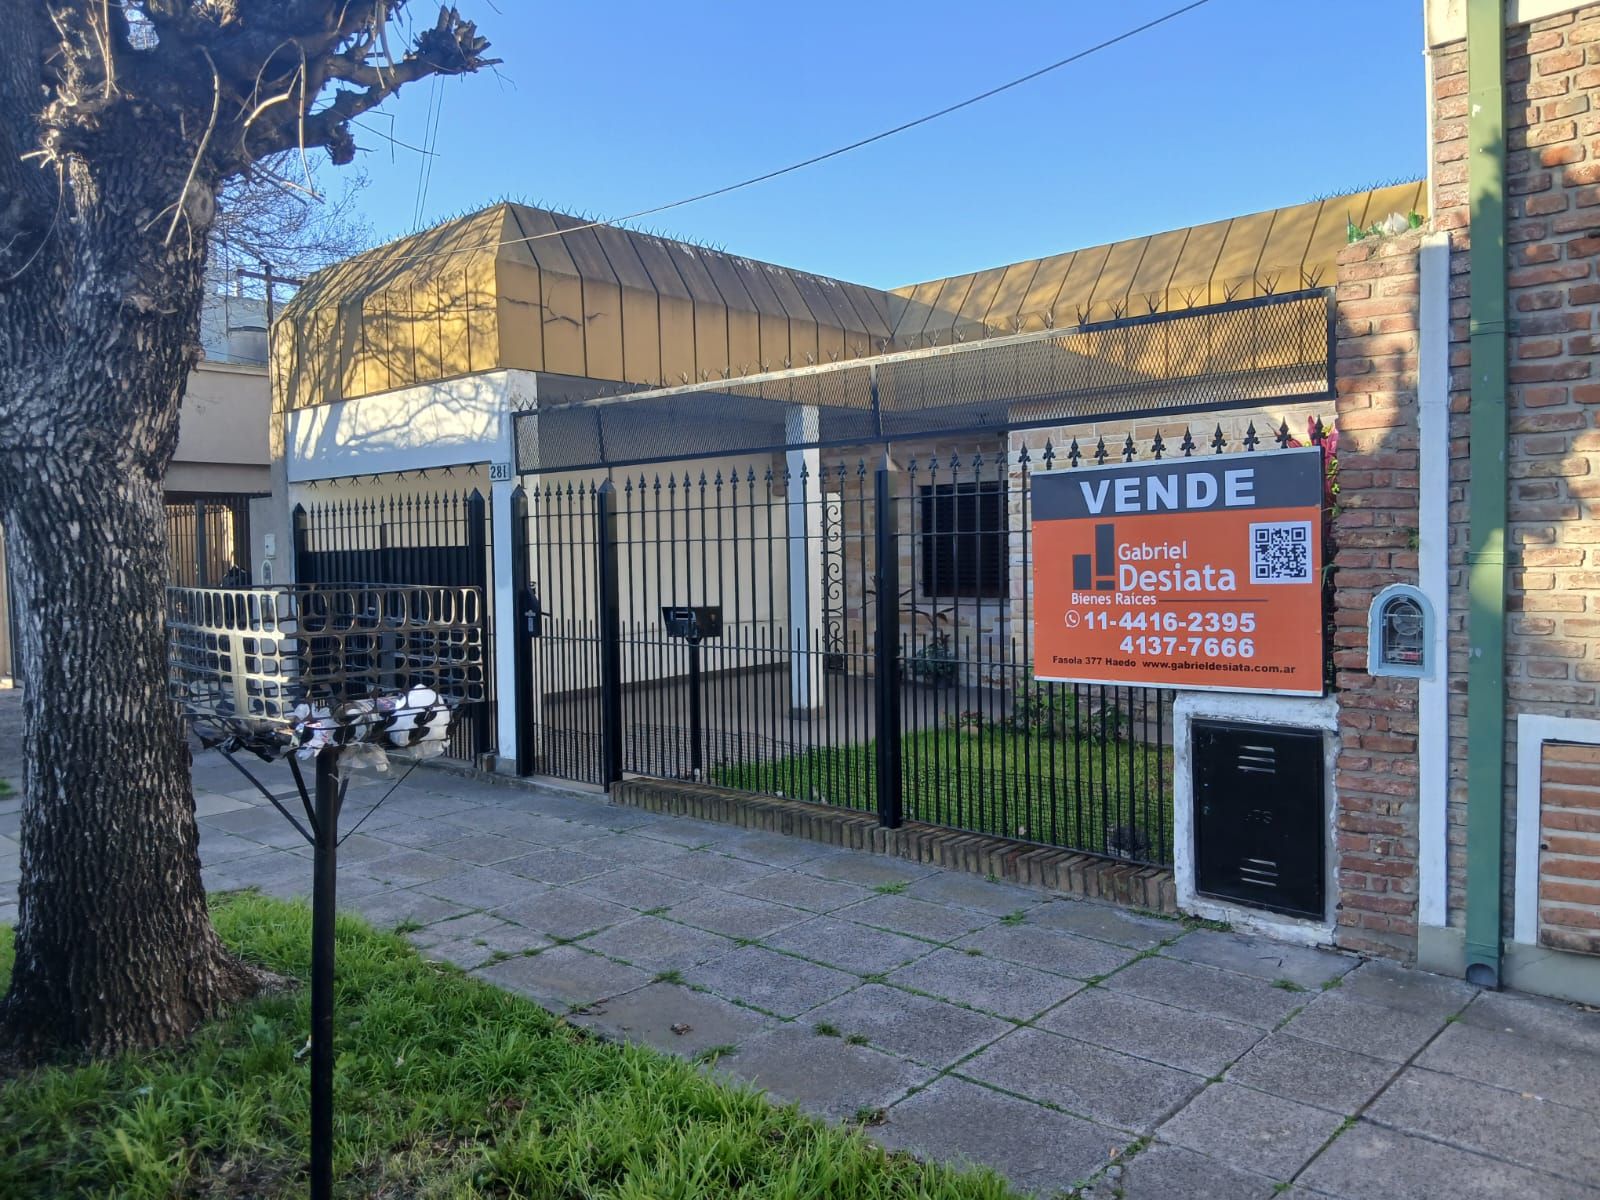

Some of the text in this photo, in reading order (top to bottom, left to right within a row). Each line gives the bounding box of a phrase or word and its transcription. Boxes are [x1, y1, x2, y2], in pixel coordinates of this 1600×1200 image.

[490, 464, 507, 479] 281
[1080, 468, 1256, 514] VENDE
[1118, 541, 1187, 561] Gabriel
[1119, 564, 1236, 592] Desiata
[1071, 593, 1111, 605] Bienes
[1084, 611, 1256, 633] 11-4416-2395
[1119, 635, 1255, 658] 4137-7666
[1052, 656, 1296, 674] Fasola 377 Haedo www.gabrieldesiata.com.ar
